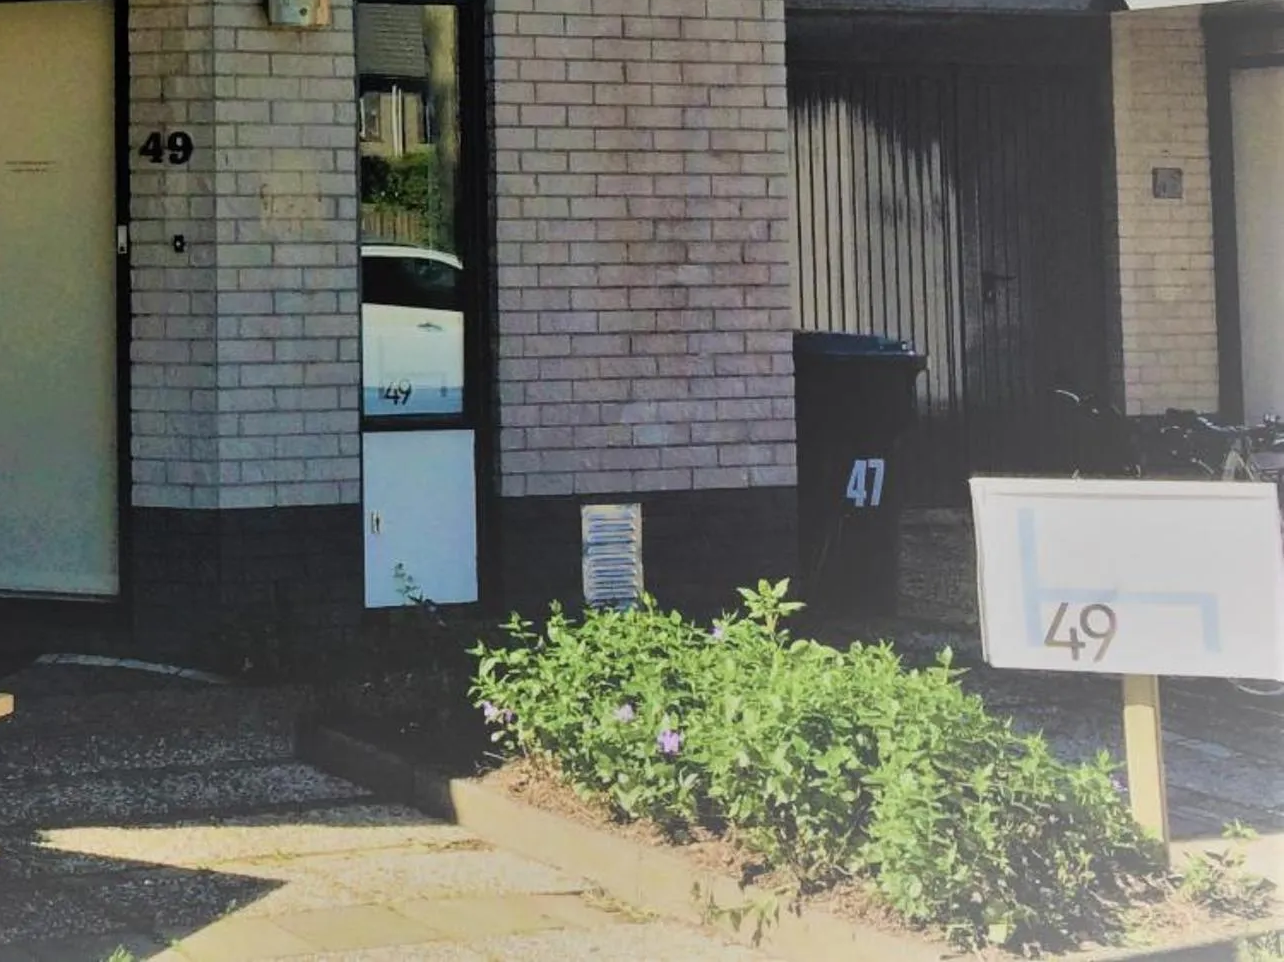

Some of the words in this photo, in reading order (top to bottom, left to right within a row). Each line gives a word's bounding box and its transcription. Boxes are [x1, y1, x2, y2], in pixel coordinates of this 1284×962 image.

[139, 131, 194, 165] 49
[384, 379, 412, 406] 49
[846, 458, 885, 507] 47
[1044, 601, 1117, 662] 49
